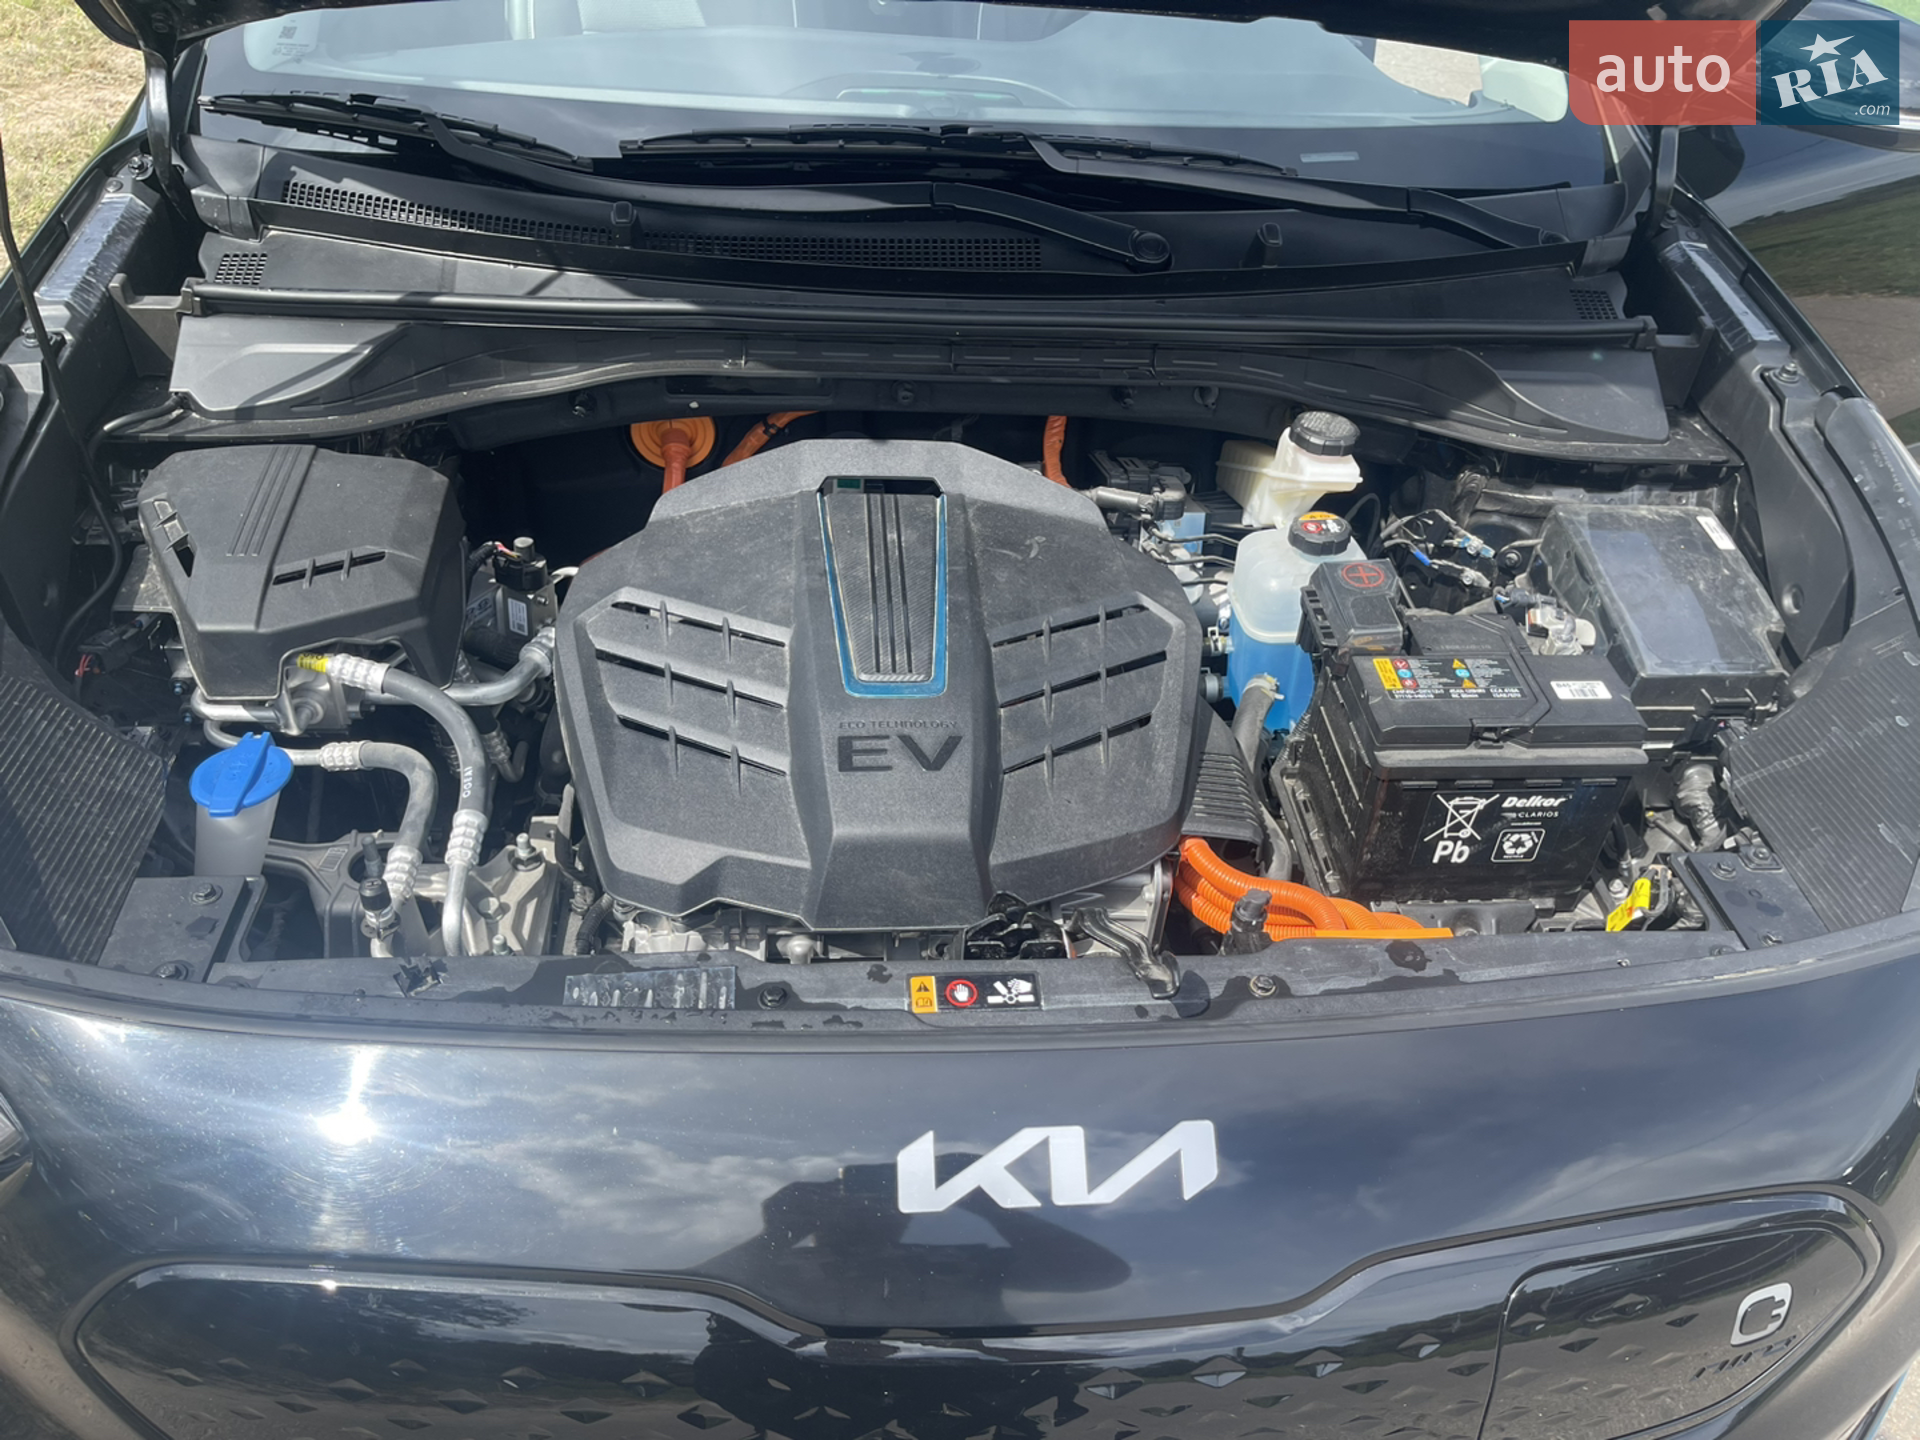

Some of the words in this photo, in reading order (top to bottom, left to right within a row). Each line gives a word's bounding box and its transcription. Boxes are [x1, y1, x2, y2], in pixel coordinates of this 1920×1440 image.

[839, 720, 866, 729] ECO
[870, 719, 958, 729] TECHNOLOGY
[837, 734, 963, 772] EV
[1501, 795, 1567, 808] Delkor
[1432, 840, 1471, 864] Pb
[896, 1119, 1219, 1214] KIA
